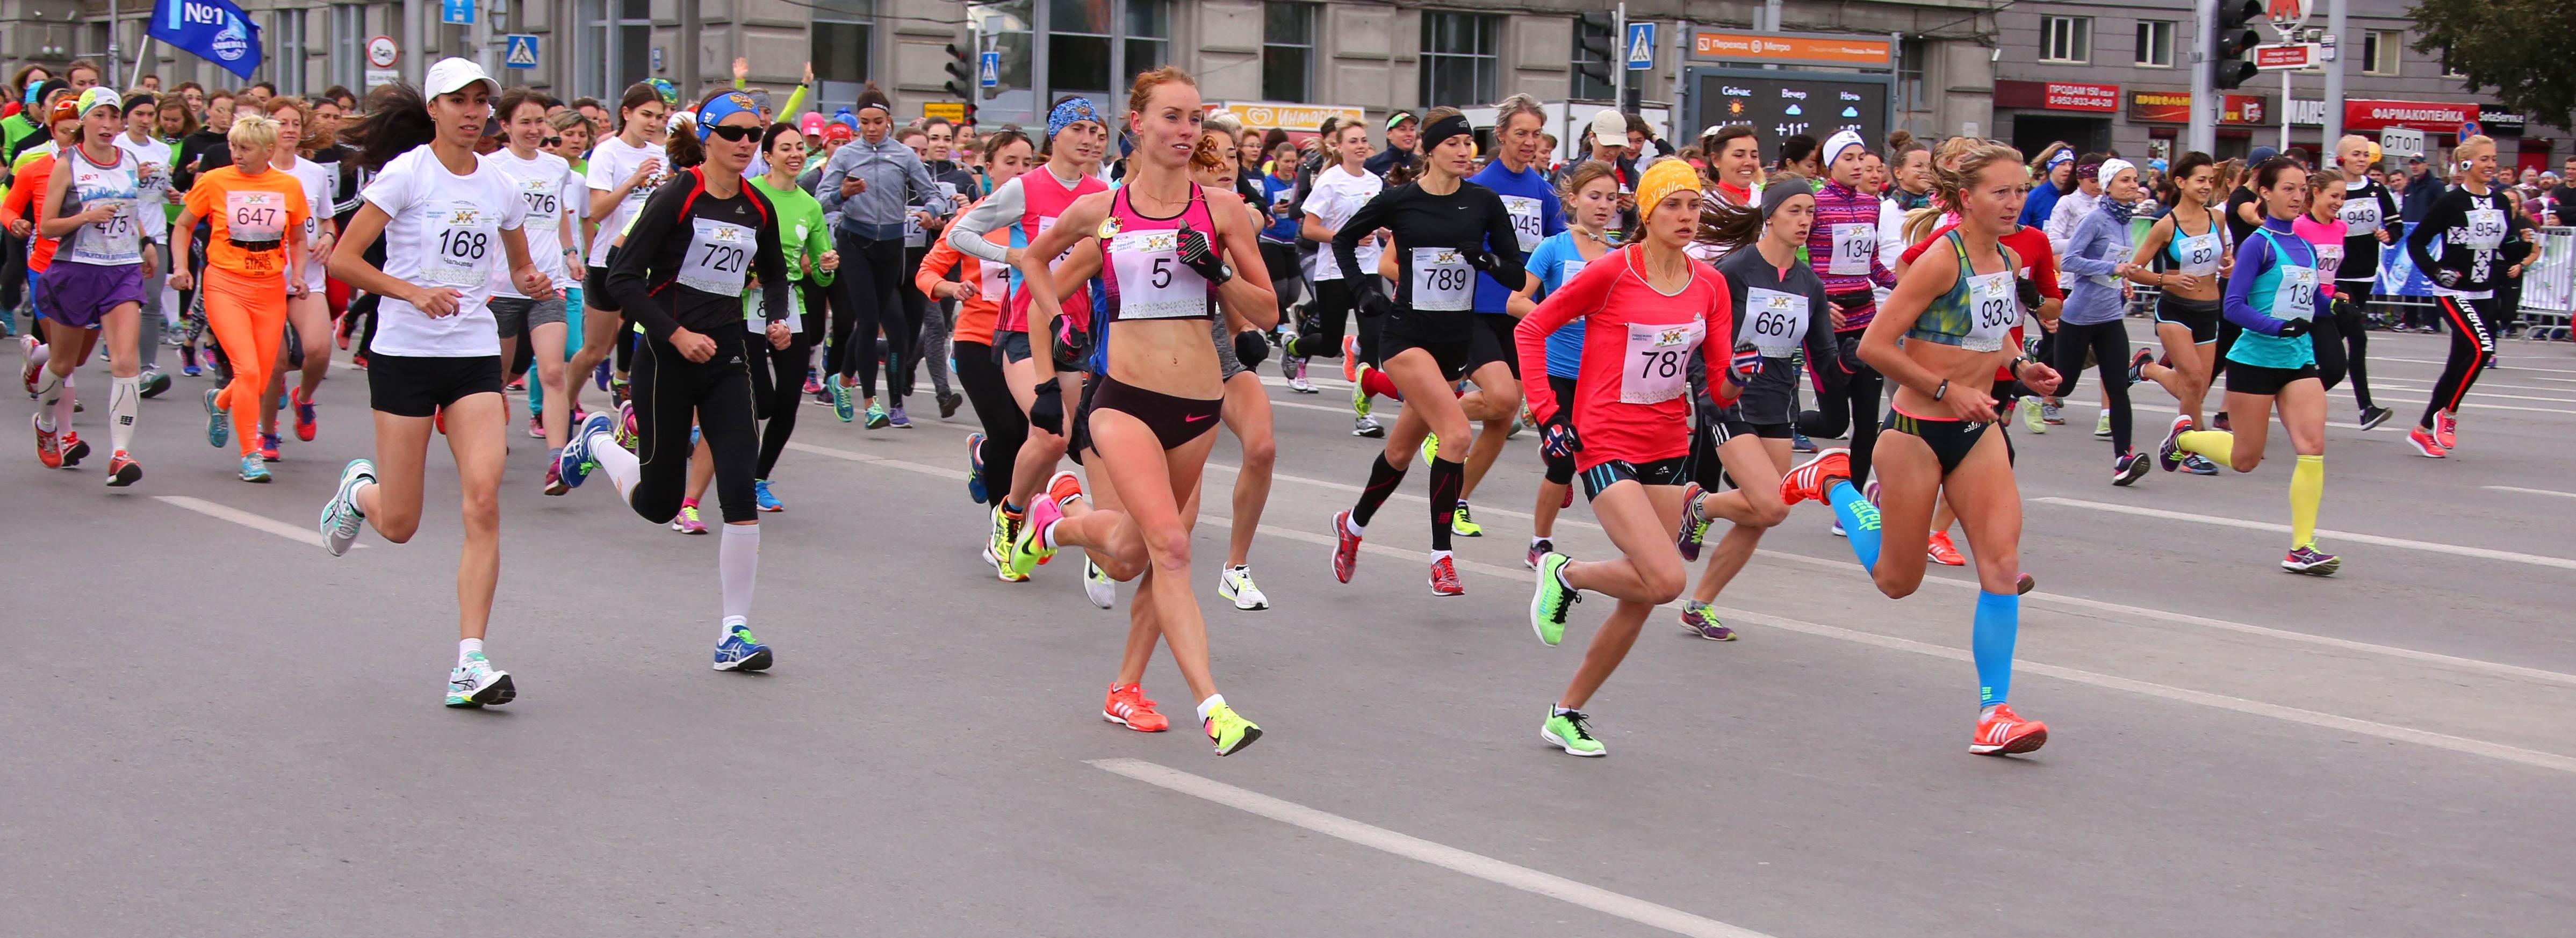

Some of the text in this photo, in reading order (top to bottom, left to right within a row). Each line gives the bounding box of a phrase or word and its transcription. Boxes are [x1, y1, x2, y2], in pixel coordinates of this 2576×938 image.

[1712, 39, 1748, 50] Переход
[1764, 42, 1791, 52] Метро
[1722, 86, 1752, 97] Сейчас
[1782, 89, 1807, 100] Вечер
[1840, 92, 1860, 100] Ночь
[2049, 84, 2085, 95] ПРОДАМ
[2372, 108, 2465, 122] ФАРМАКОПЕЙКА
[2384, 135, 2421, 150] СТОП
[237, 207, 276, 226] 647
[2348, 210, 2375, 225] 943
[2476, 222, 2501, 236] 954
[439, 228, 487, 259] 168
[1844, 239, 1872, 258] 134
[701, 243, 744, 273] 720
[2193, 248, 2212, 264] 82
[1152, 258, 1172, 288] 5
[1424, 269, 1466, 291] 789
[1982, 298, 2014, 329] 933
[1755, 312, 1796, 339] 661
[1642, 346, 1692, 378] 787
